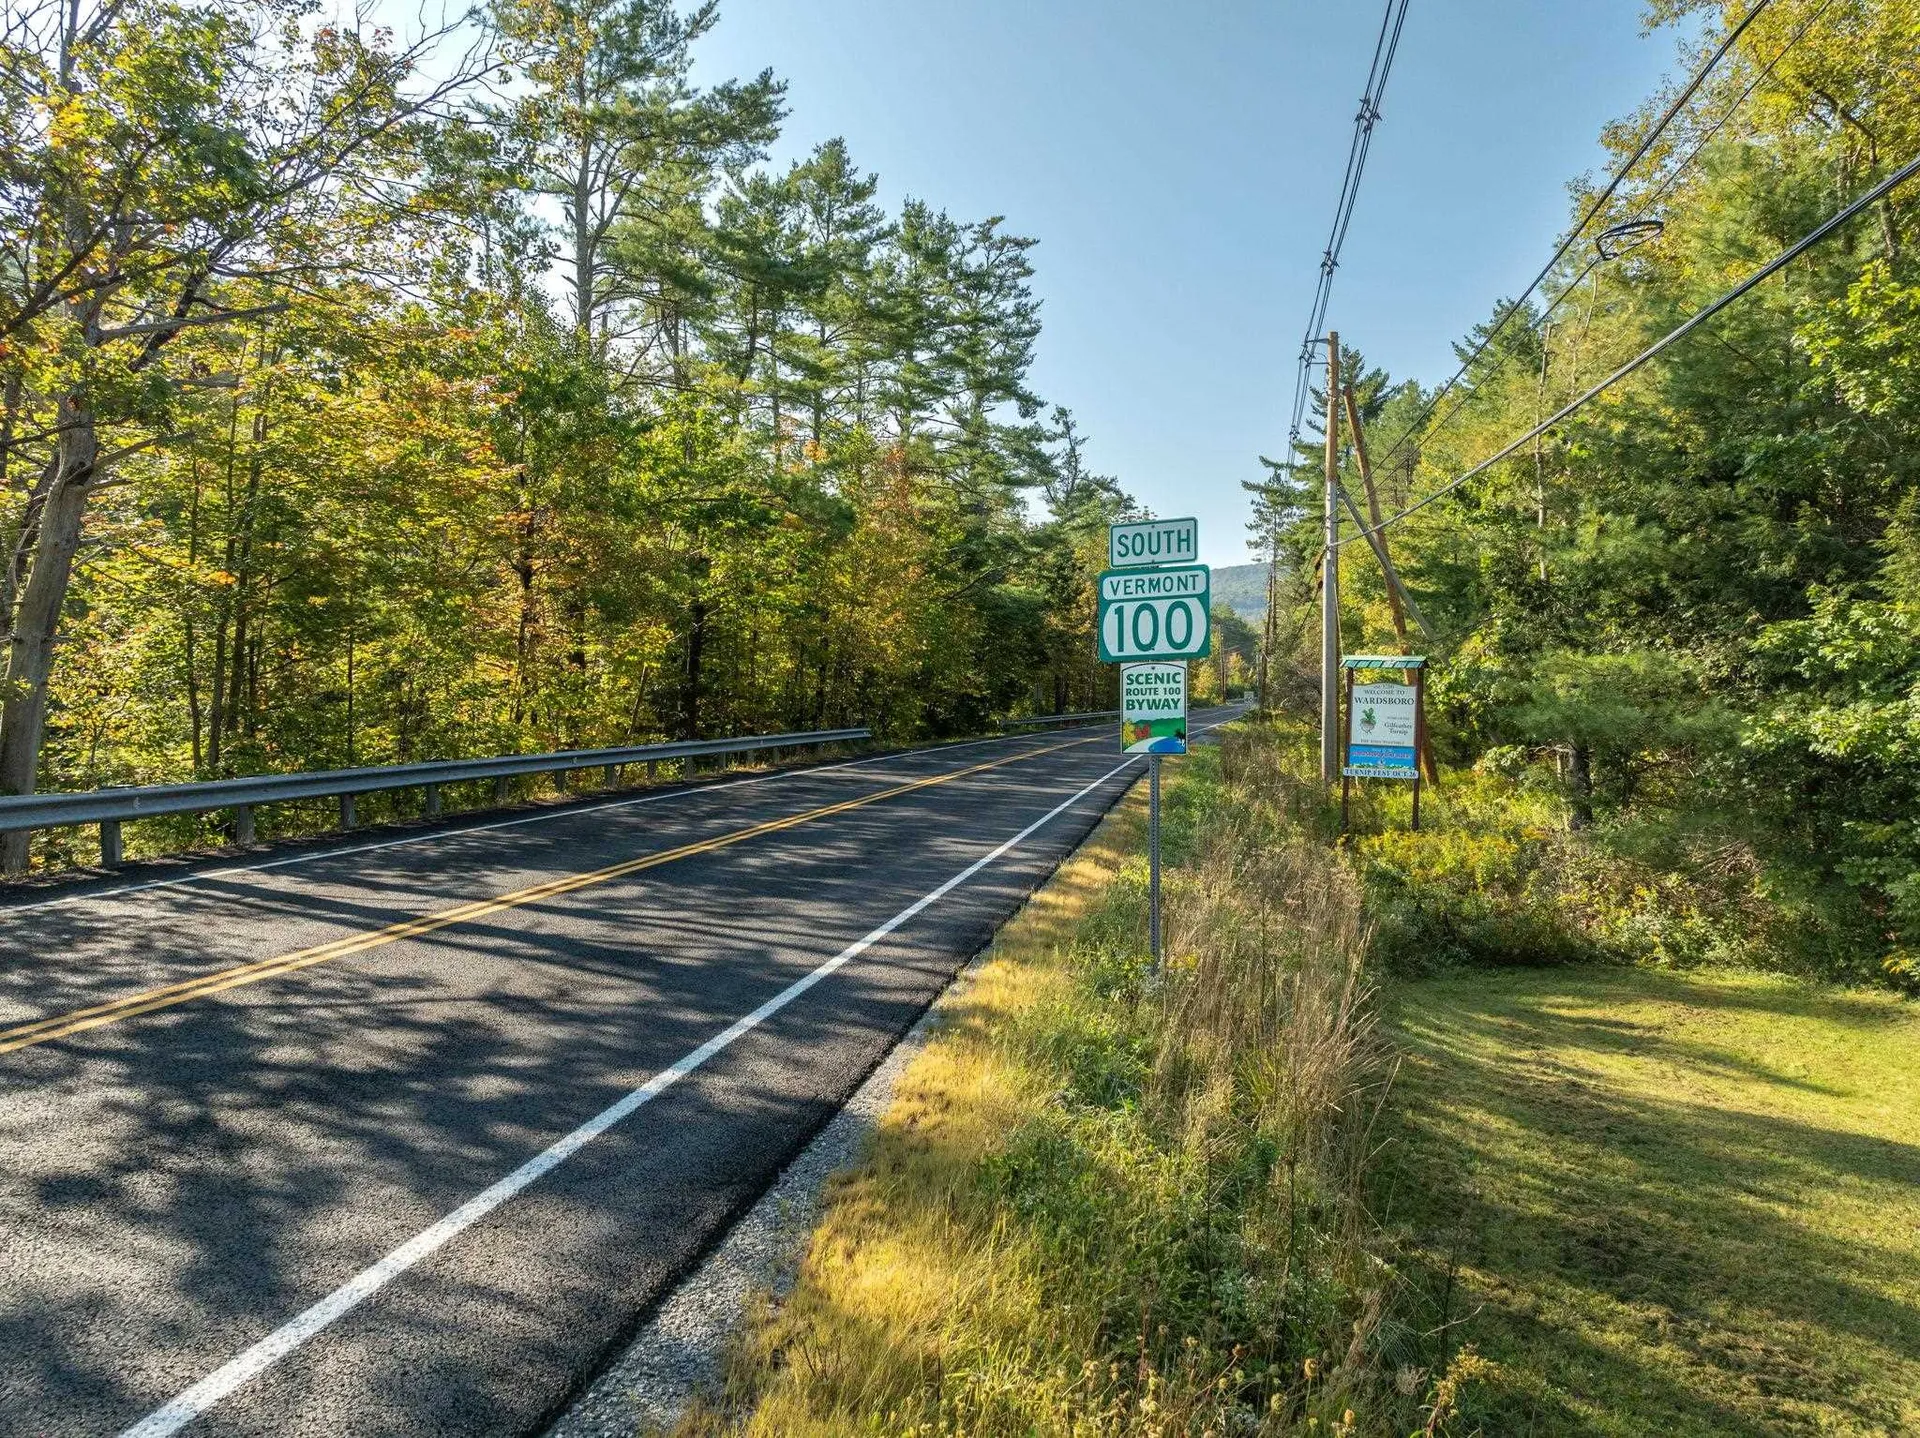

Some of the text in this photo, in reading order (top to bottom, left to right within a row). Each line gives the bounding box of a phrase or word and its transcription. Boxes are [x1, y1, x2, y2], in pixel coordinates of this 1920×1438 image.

[1117, 529, 1191, 558] SOUTH
[1110, 574, 1199, 596] VERMONT
[1114, 601, 1193, 652] 100
[1126, 672, 1181, 685] SCENIC
[1126, 686, 1181, 696] ROUTE 100
[1125, 698, 1181, 711] BYWAY
[1354, 697, 1415, 705] WARDSBORO
